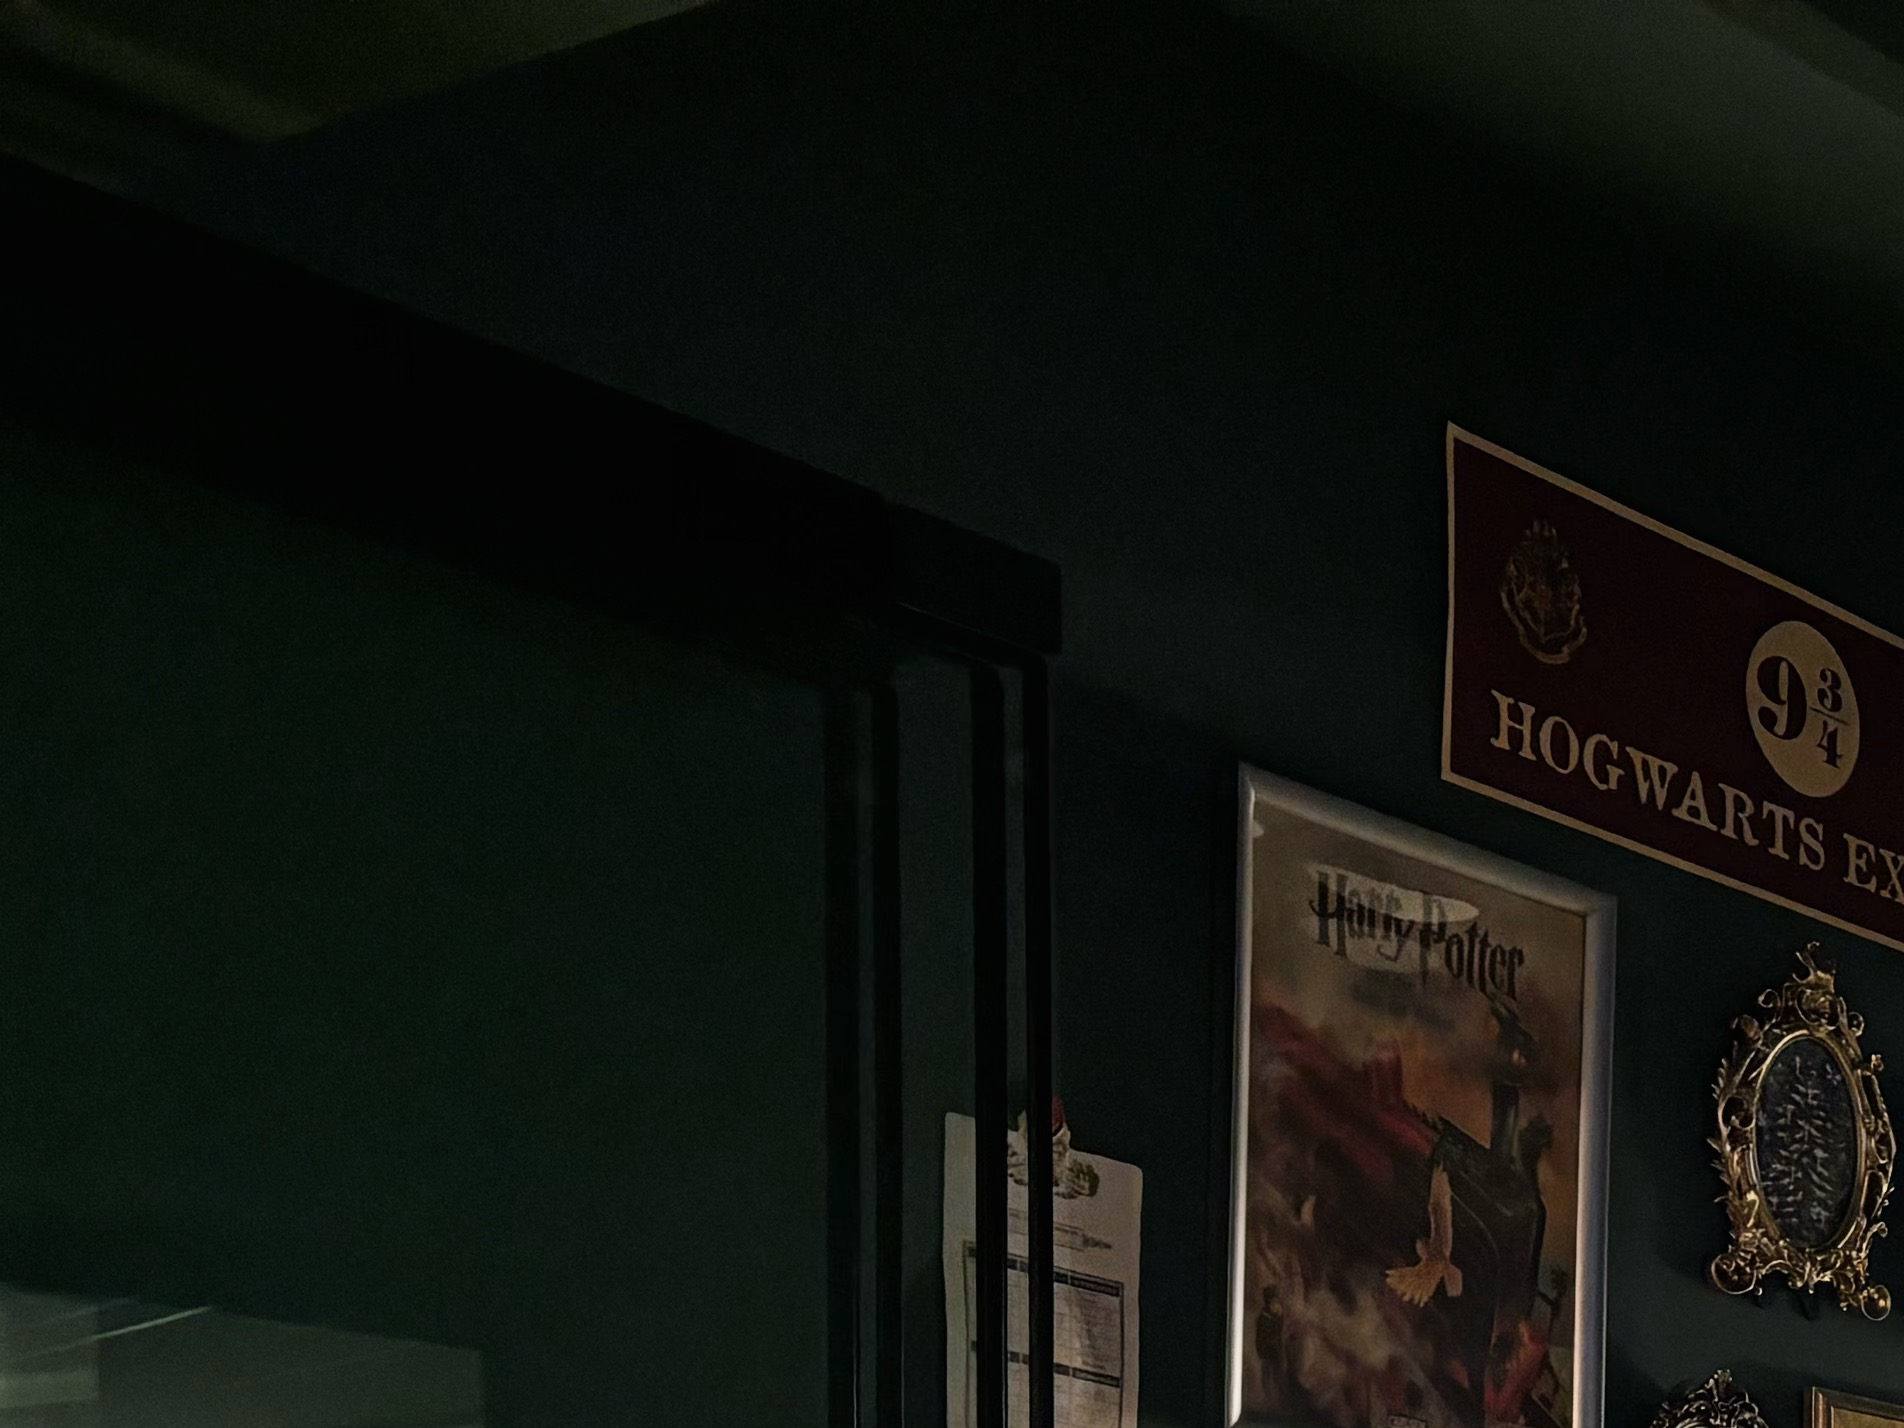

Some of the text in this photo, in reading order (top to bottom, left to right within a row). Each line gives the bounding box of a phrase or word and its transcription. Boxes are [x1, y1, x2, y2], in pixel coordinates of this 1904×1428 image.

[1490, 690, 1825, 871] HOGWARTS
[1309, 870, 1525, 1001] Harry Potter
